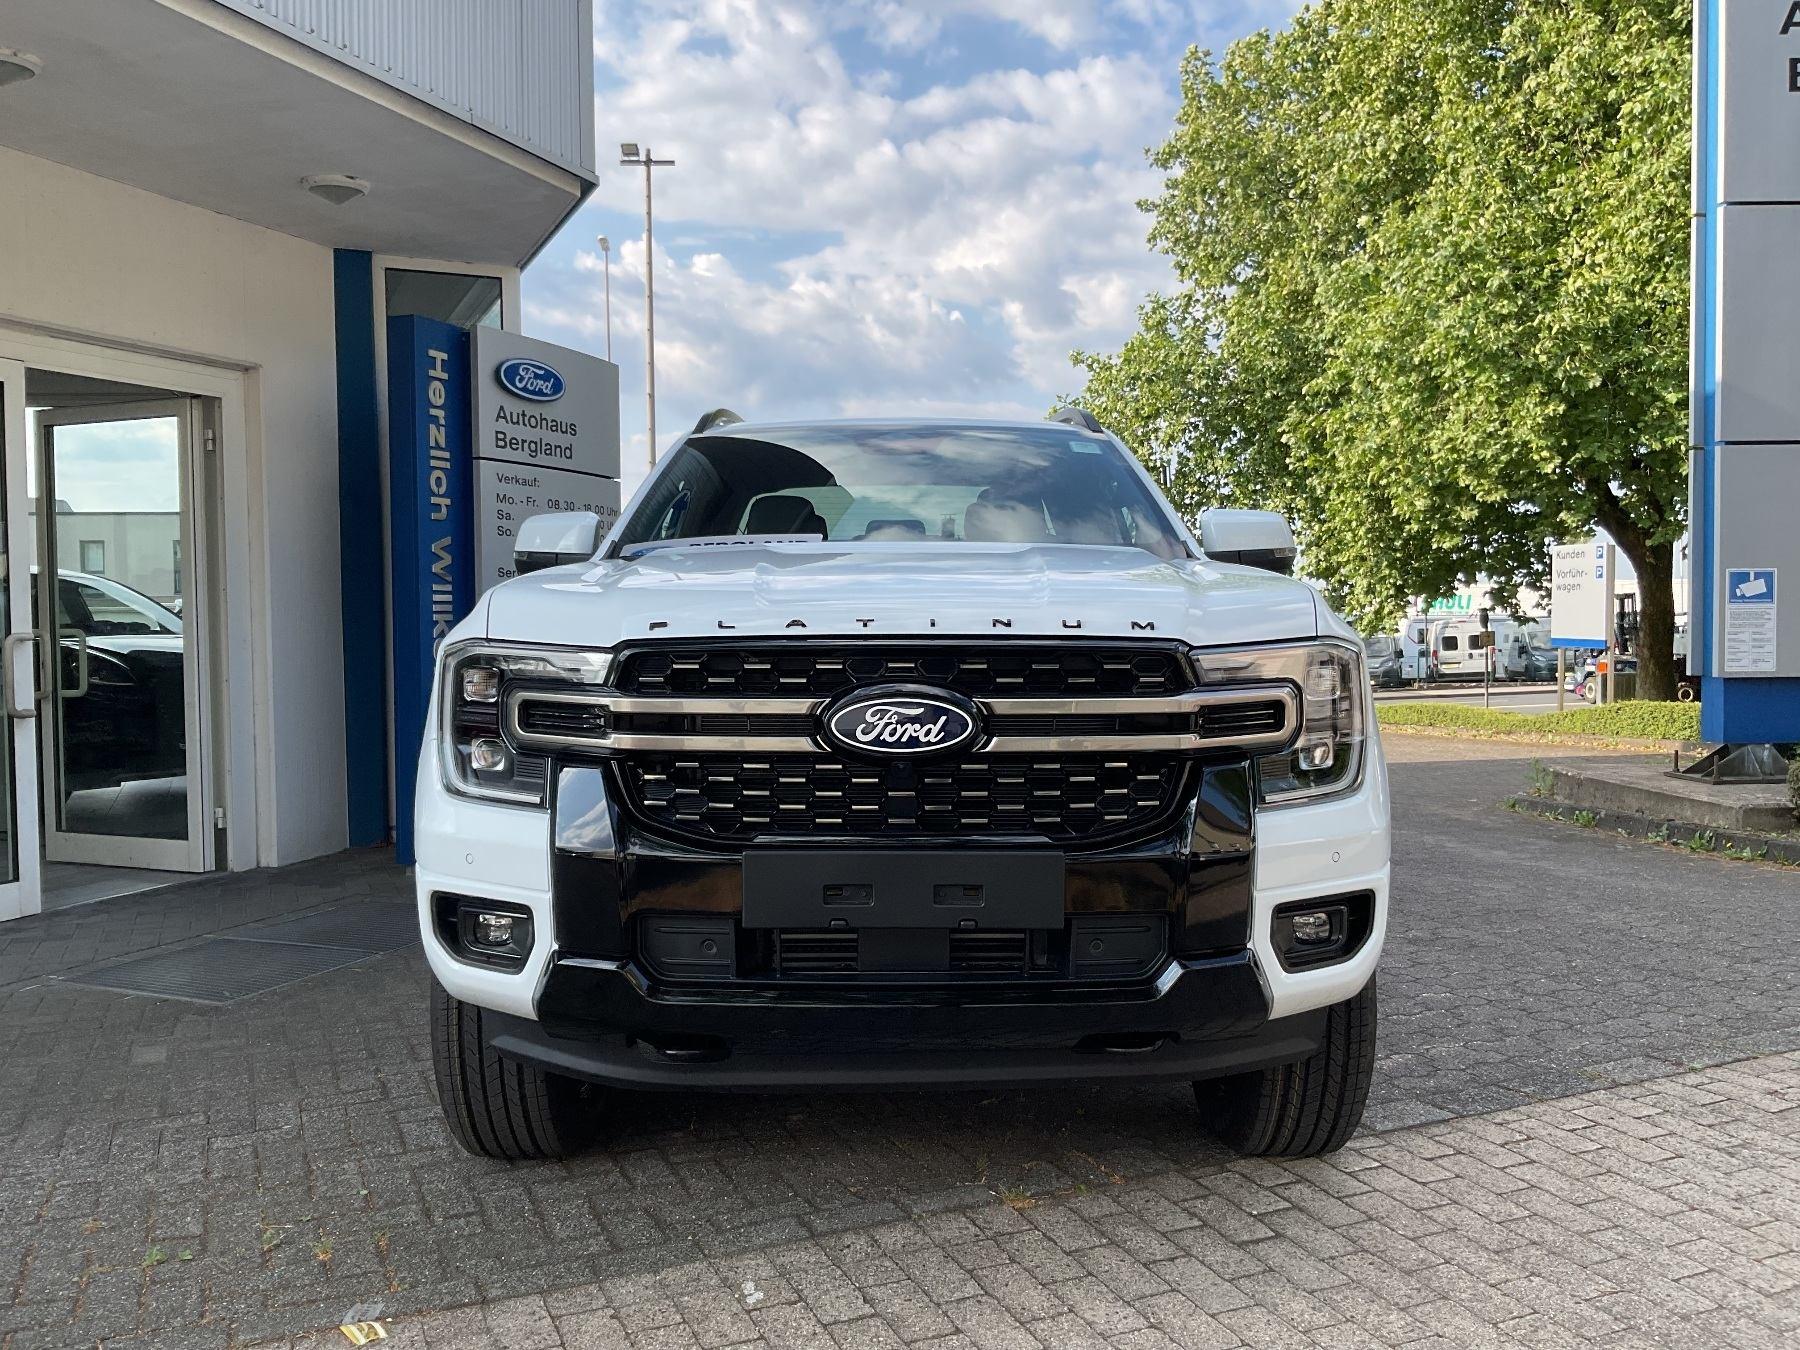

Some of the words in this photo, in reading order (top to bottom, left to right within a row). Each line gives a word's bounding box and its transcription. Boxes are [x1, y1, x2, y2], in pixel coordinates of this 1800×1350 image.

[515, 364, 554, 394] Ford
[495, 405, 578, 436] Autohaus
[428, 349, 451, 521] Herzlich
[495, 430, 573, 460] Bergland
[496, 473, 540, 488] Verkauf:
[496, 493, 518, 505] Mo.
[526, 497, 539, 508] Fr.
[547, 499, 575, 511] 08.30
[606, 506, 619, 517] Uhr
[496, 509, 515, 521] Sa.
[497, 525, 515, 537] So.
[1556, 549, 1585, 560] Kunden
[1556, 583, 1581, 593] wagen
[649, 618, 1155, 631] PLATINUM
[855, 705, 947, 743] Ford
